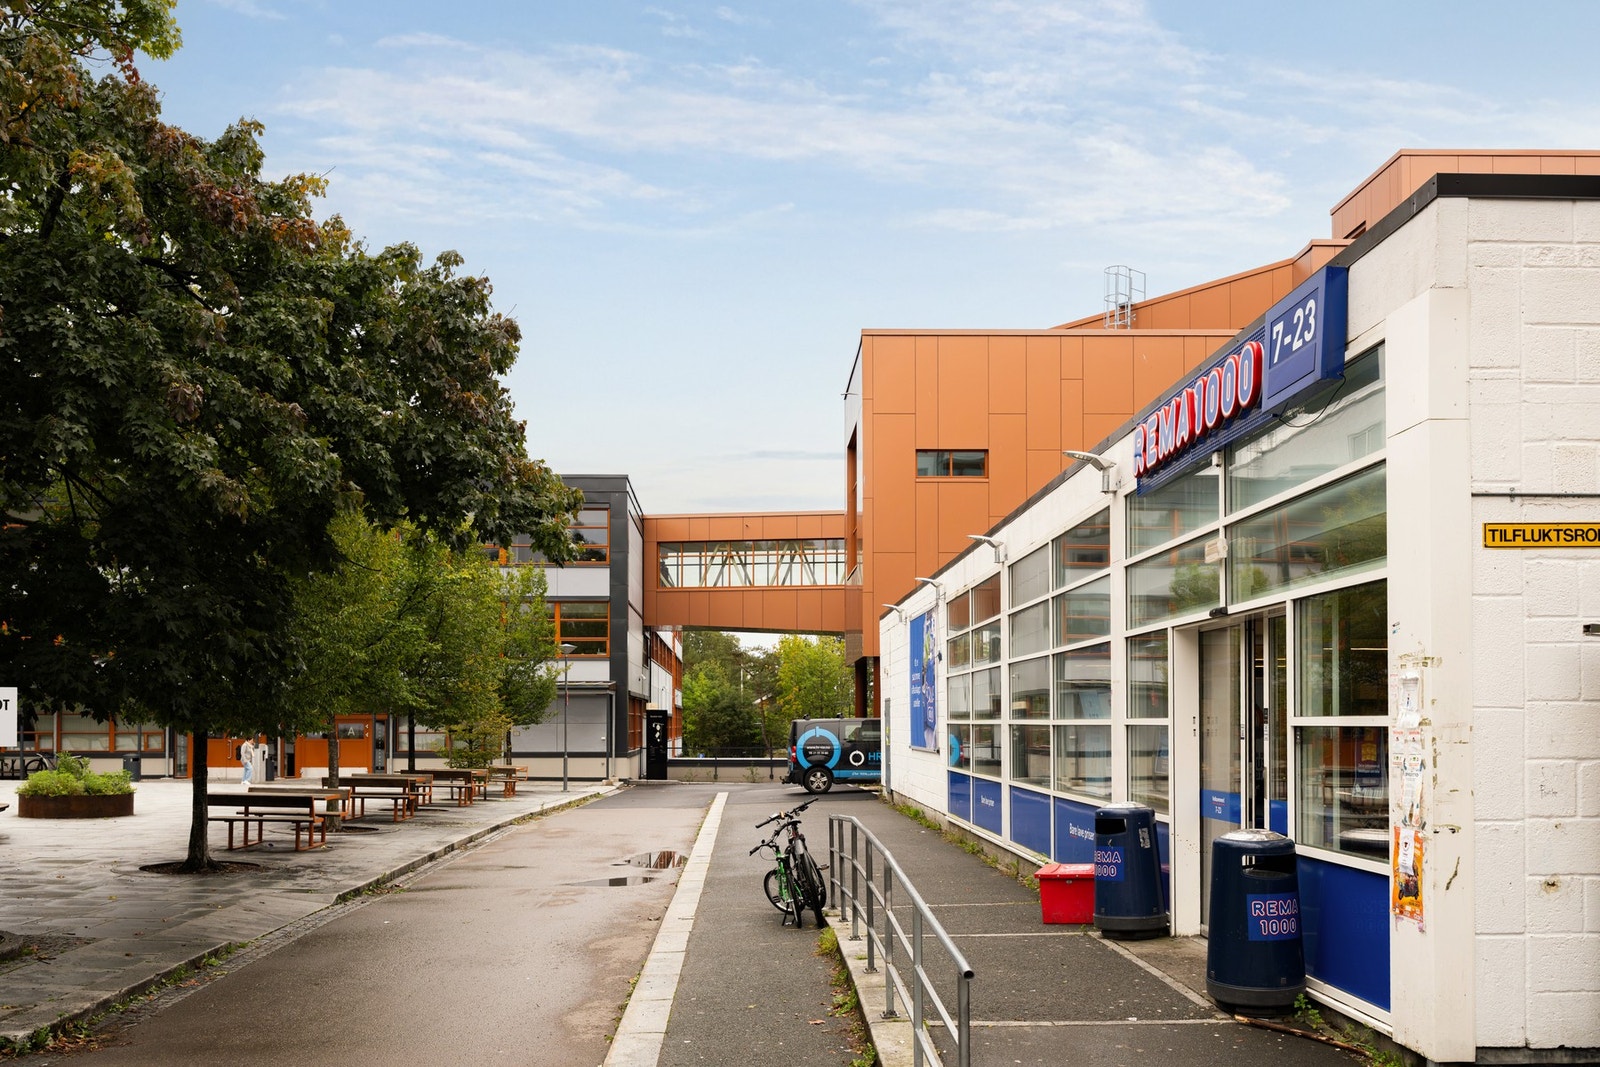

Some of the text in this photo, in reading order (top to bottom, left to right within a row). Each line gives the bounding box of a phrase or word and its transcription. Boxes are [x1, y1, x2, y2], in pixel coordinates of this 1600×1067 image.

[1272, 298, 1316, 364] 7-23
[1134, 341, 1265, 478] REMA 1000
[1488, 528, 1600, 543] TILFLUKTSRO
[1069, 822, 1077, 836] Bare
[1251, 898, 1299, 917] REMA
[1259, 917, 1297, 936] 1000
